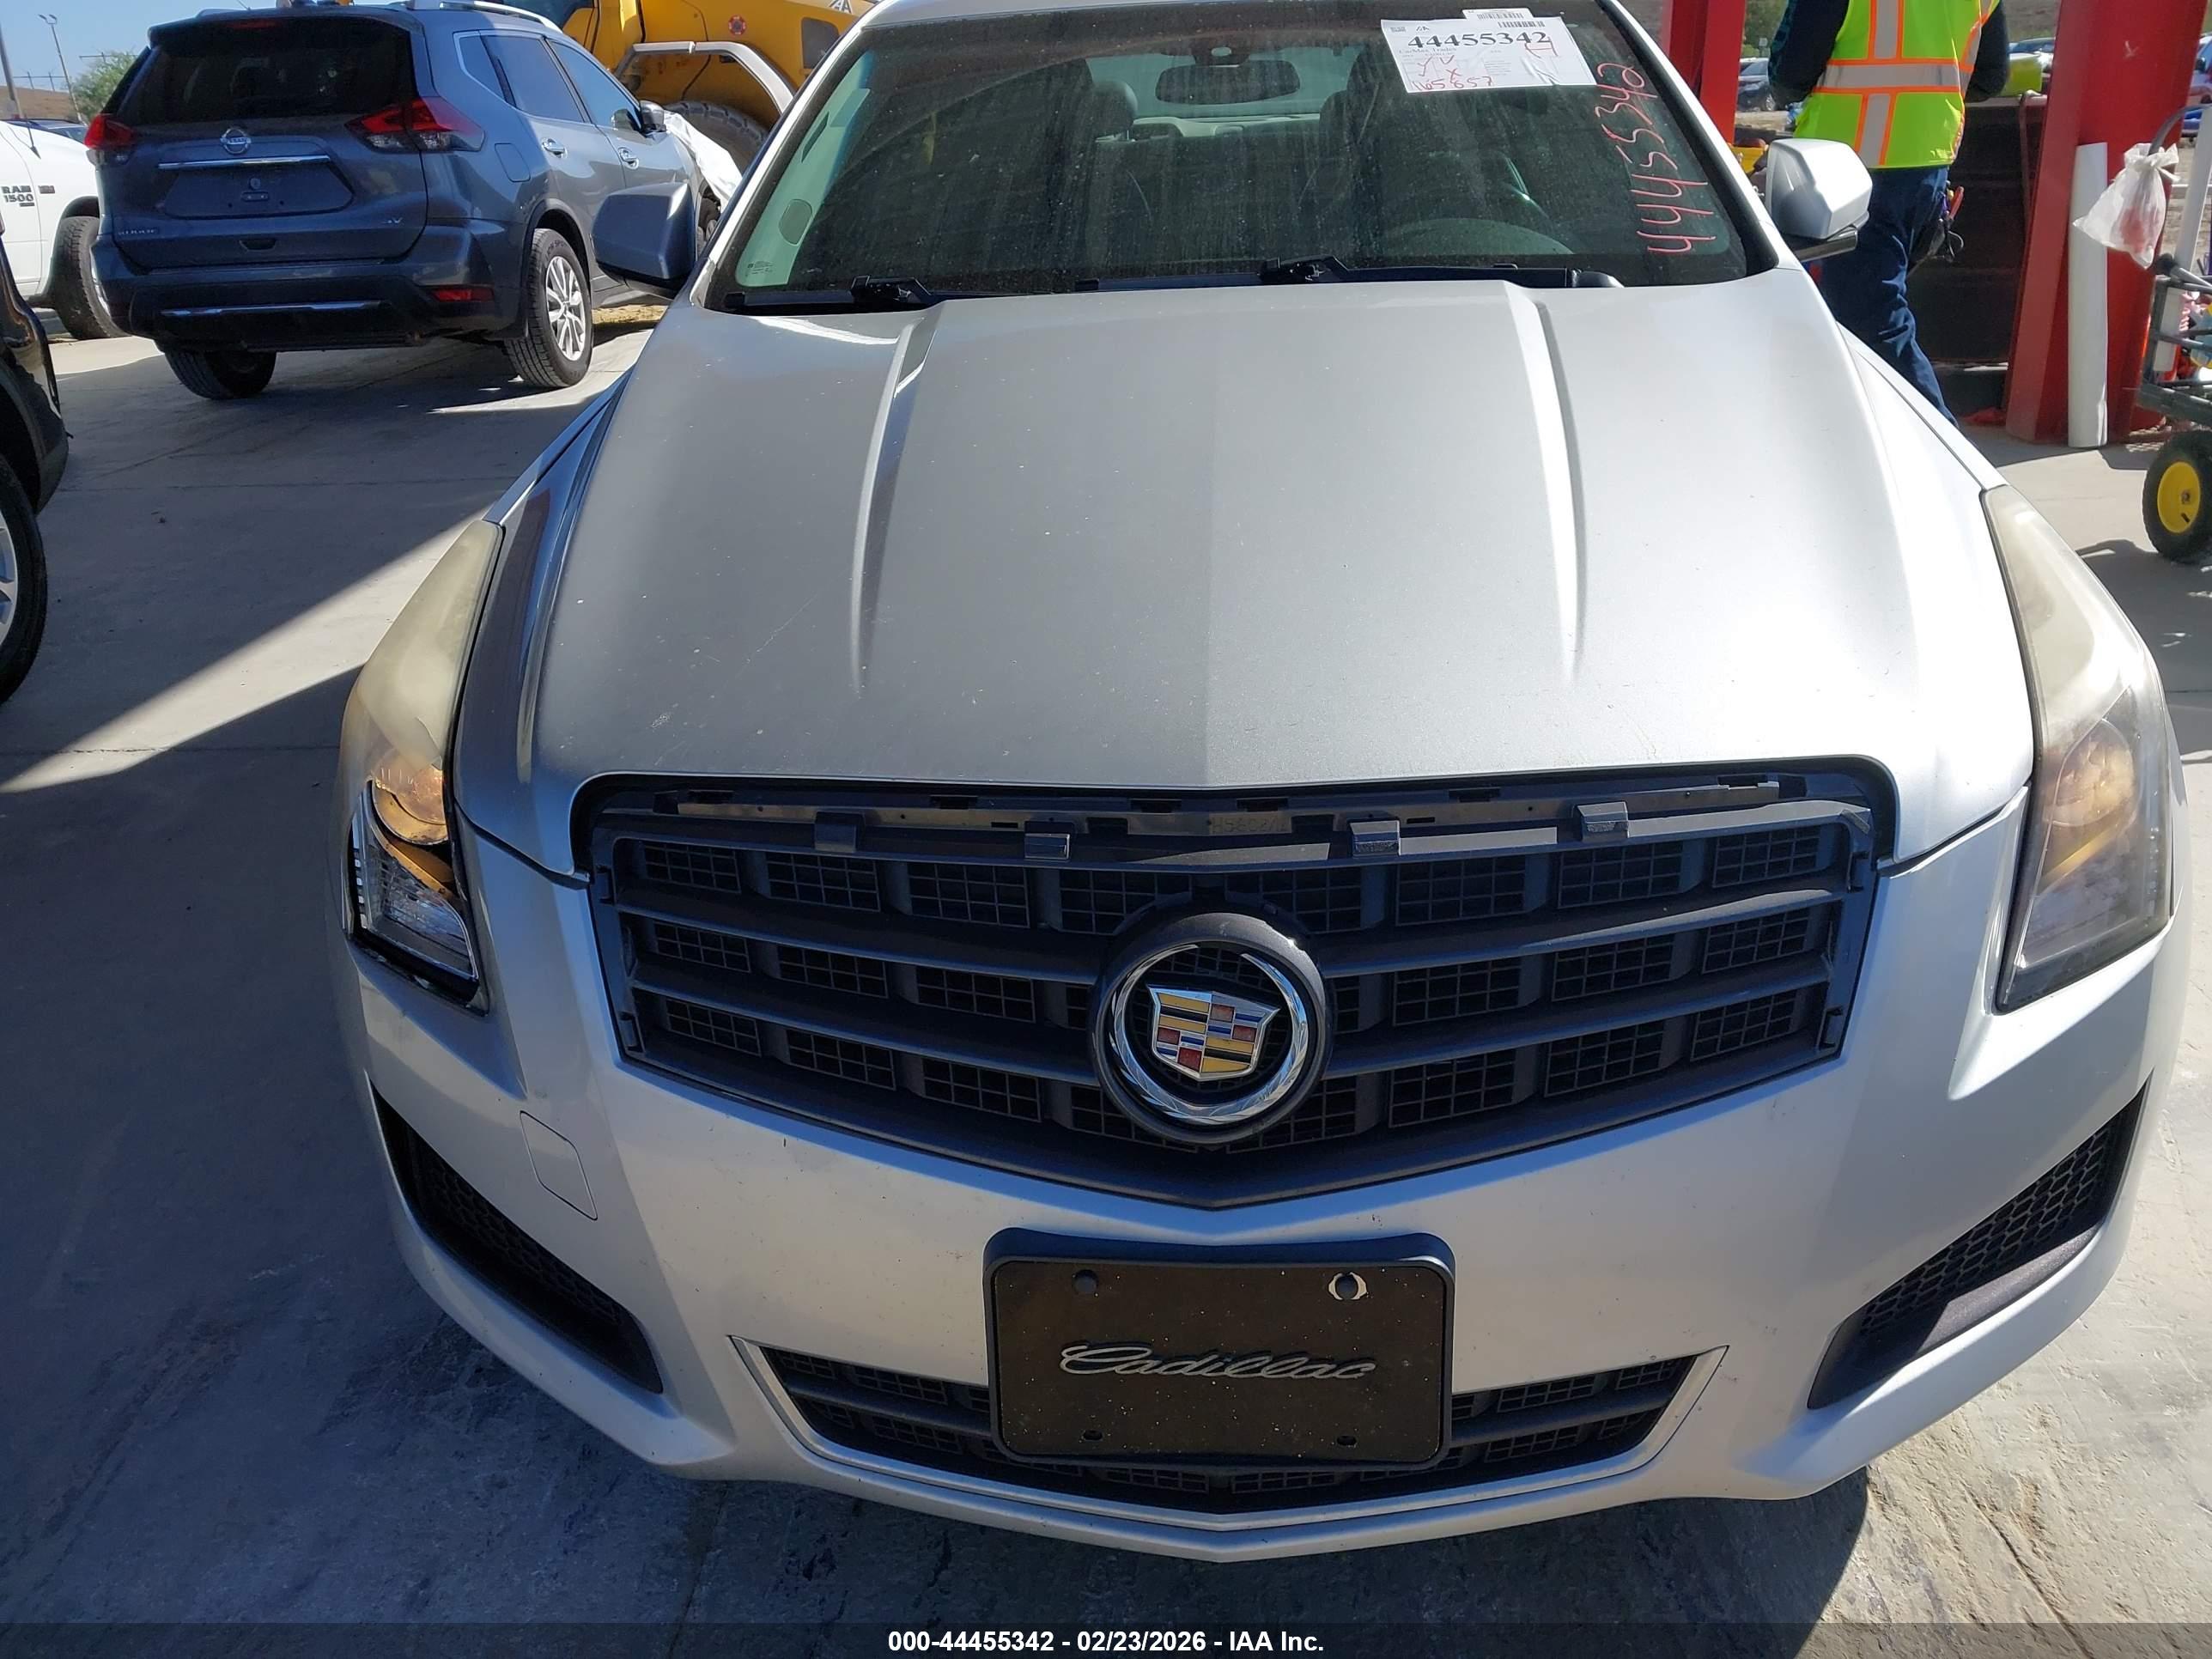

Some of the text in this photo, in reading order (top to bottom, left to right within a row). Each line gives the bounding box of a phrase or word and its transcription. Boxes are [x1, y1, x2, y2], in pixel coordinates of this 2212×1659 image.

[1407, 31, 1552, 48] 44455342
[1, 185, 33, 194] RAM
[3, 193, 34, 203] 1500
[1060, 1343, 1376, 1379] Cadillac
